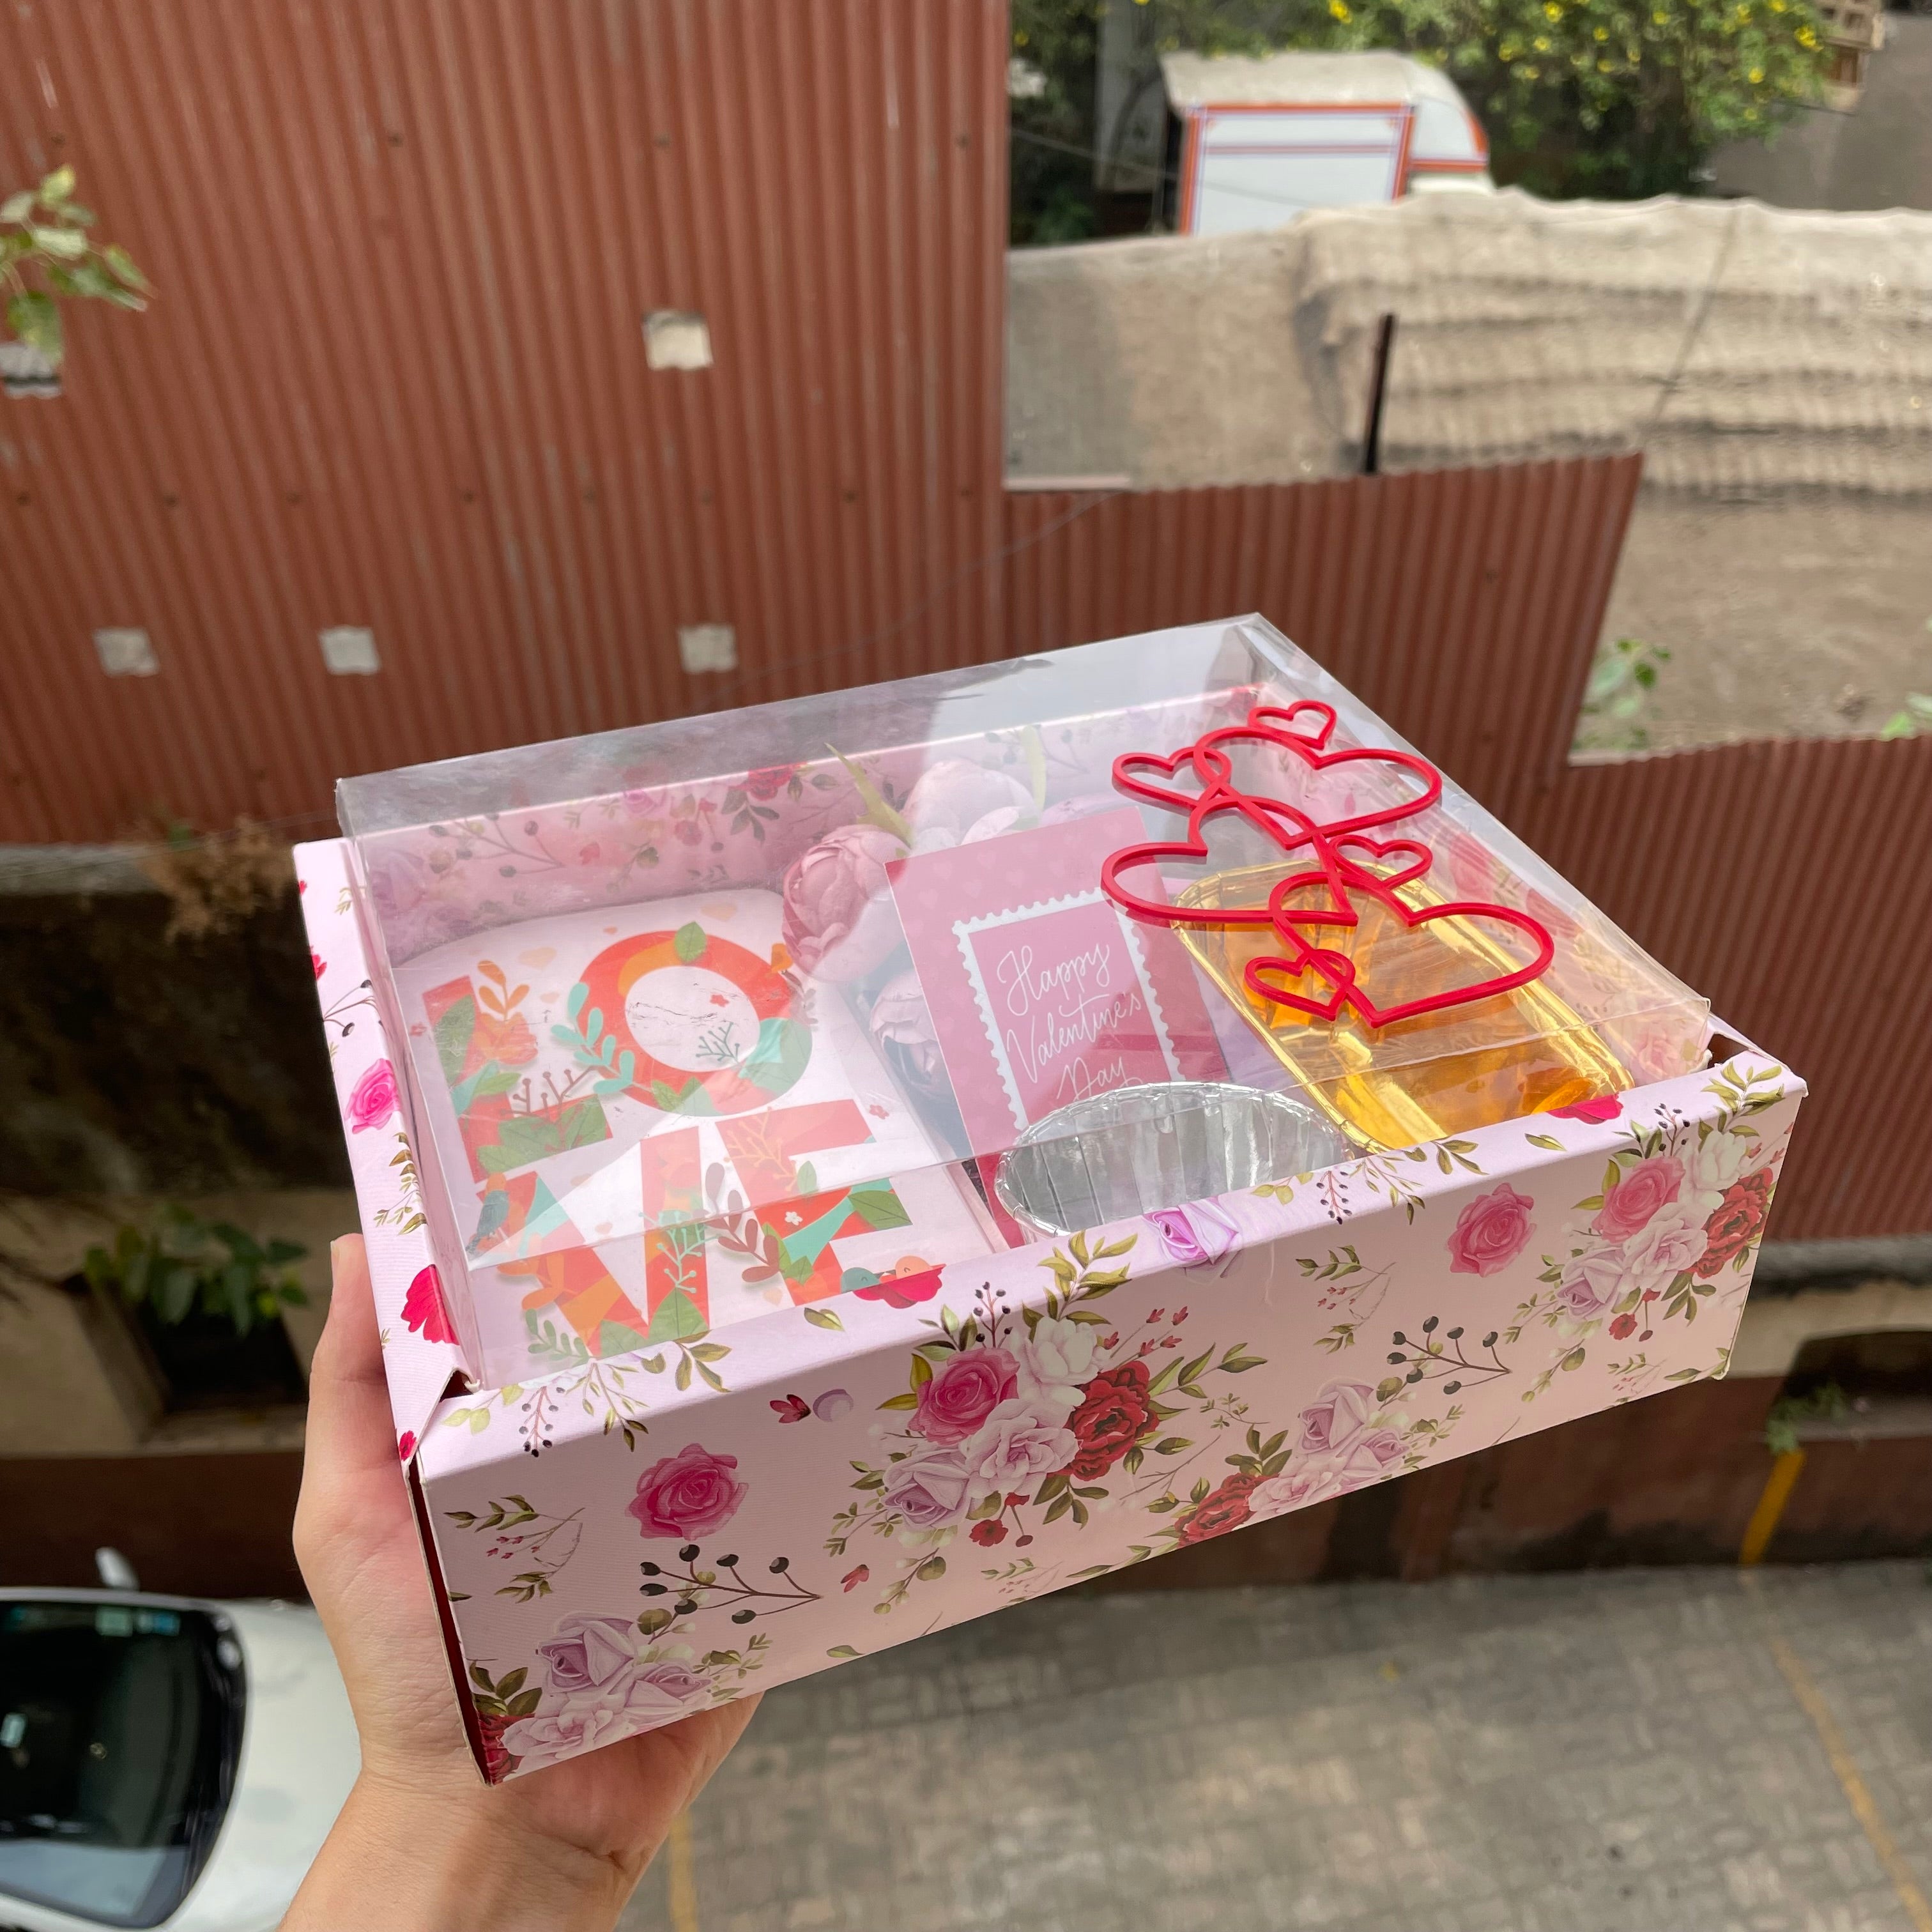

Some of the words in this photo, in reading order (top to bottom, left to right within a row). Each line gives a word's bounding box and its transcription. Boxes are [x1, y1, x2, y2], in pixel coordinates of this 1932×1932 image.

[997, 945, 1110, 1016] Happy
[1007, 992, 1142, 1084] Valentine's
[1056, 1057, 1143, 1101] Day
